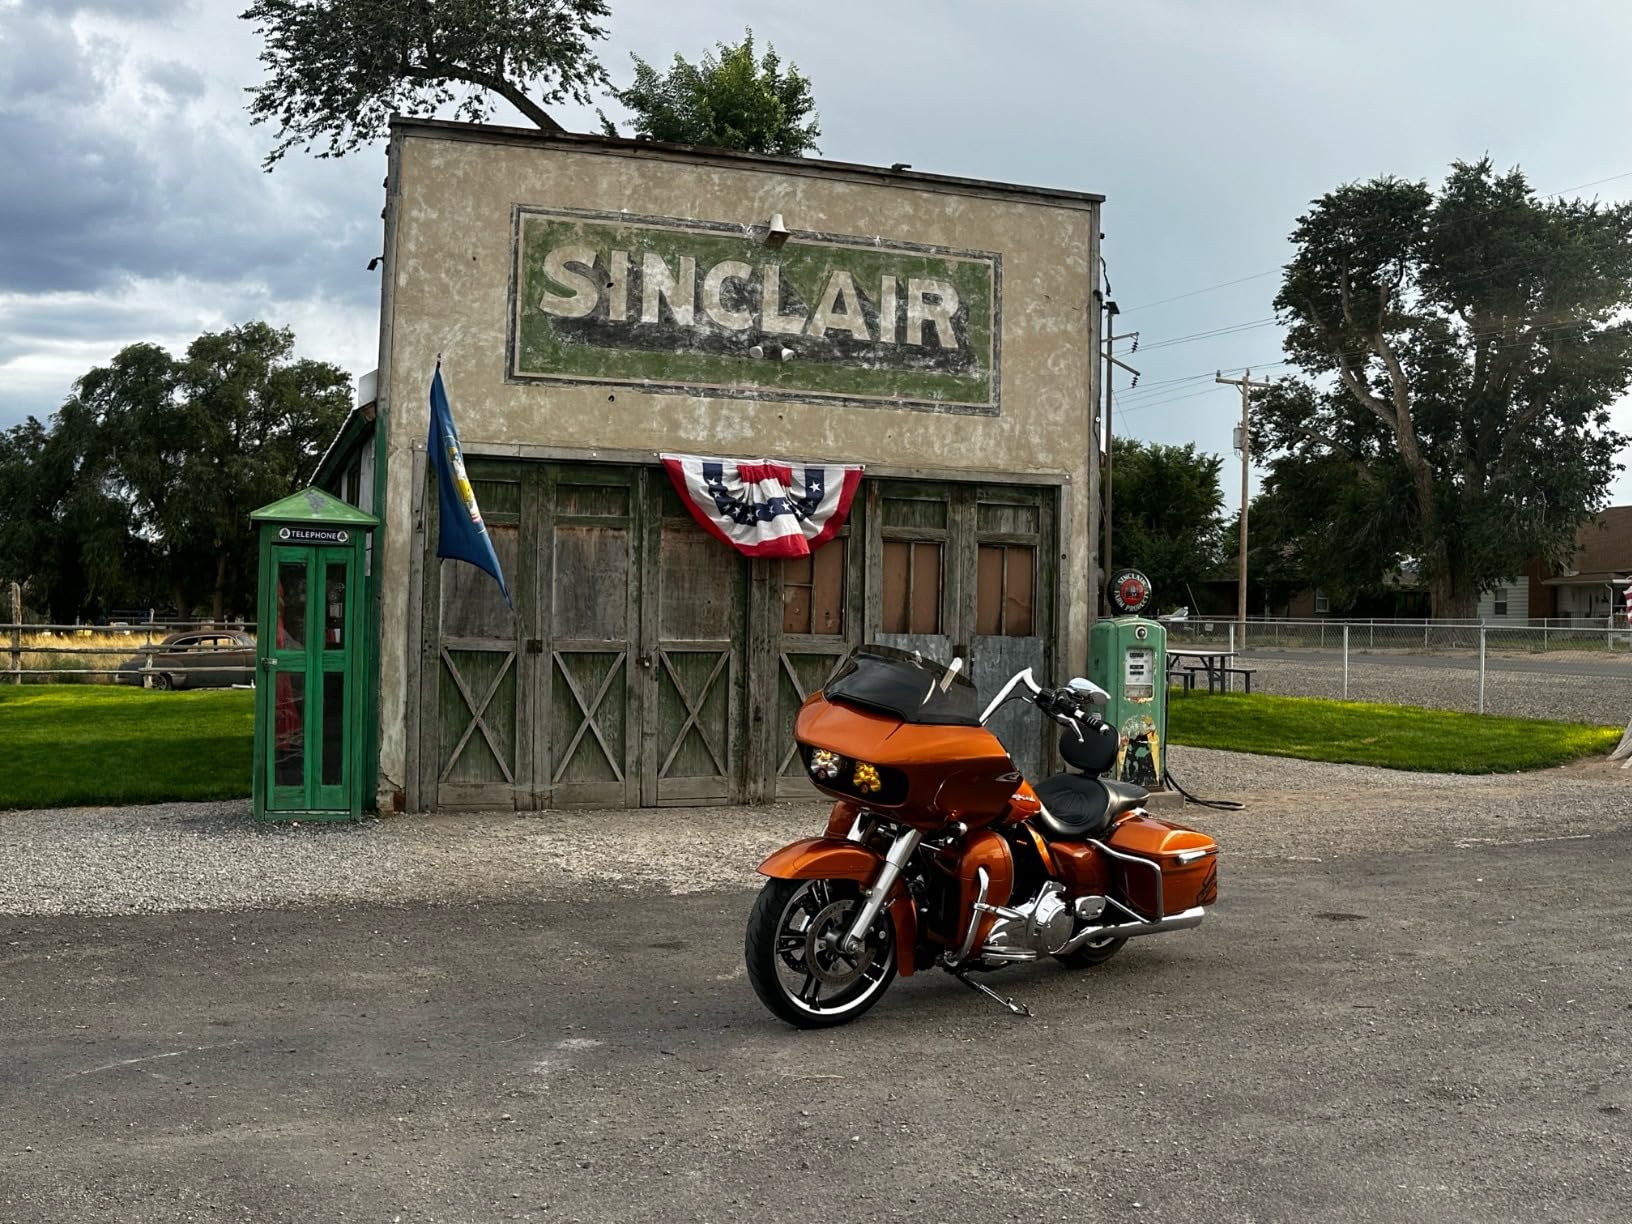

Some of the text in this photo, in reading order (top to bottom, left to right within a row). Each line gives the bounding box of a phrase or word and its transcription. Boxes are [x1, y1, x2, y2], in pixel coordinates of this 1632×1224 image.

[539, 245, 959, 348] SINCLAIR
[291, 530, 337, 540] TELEPHONE
[1117, 573, 1147, 586] SINCLAIR
